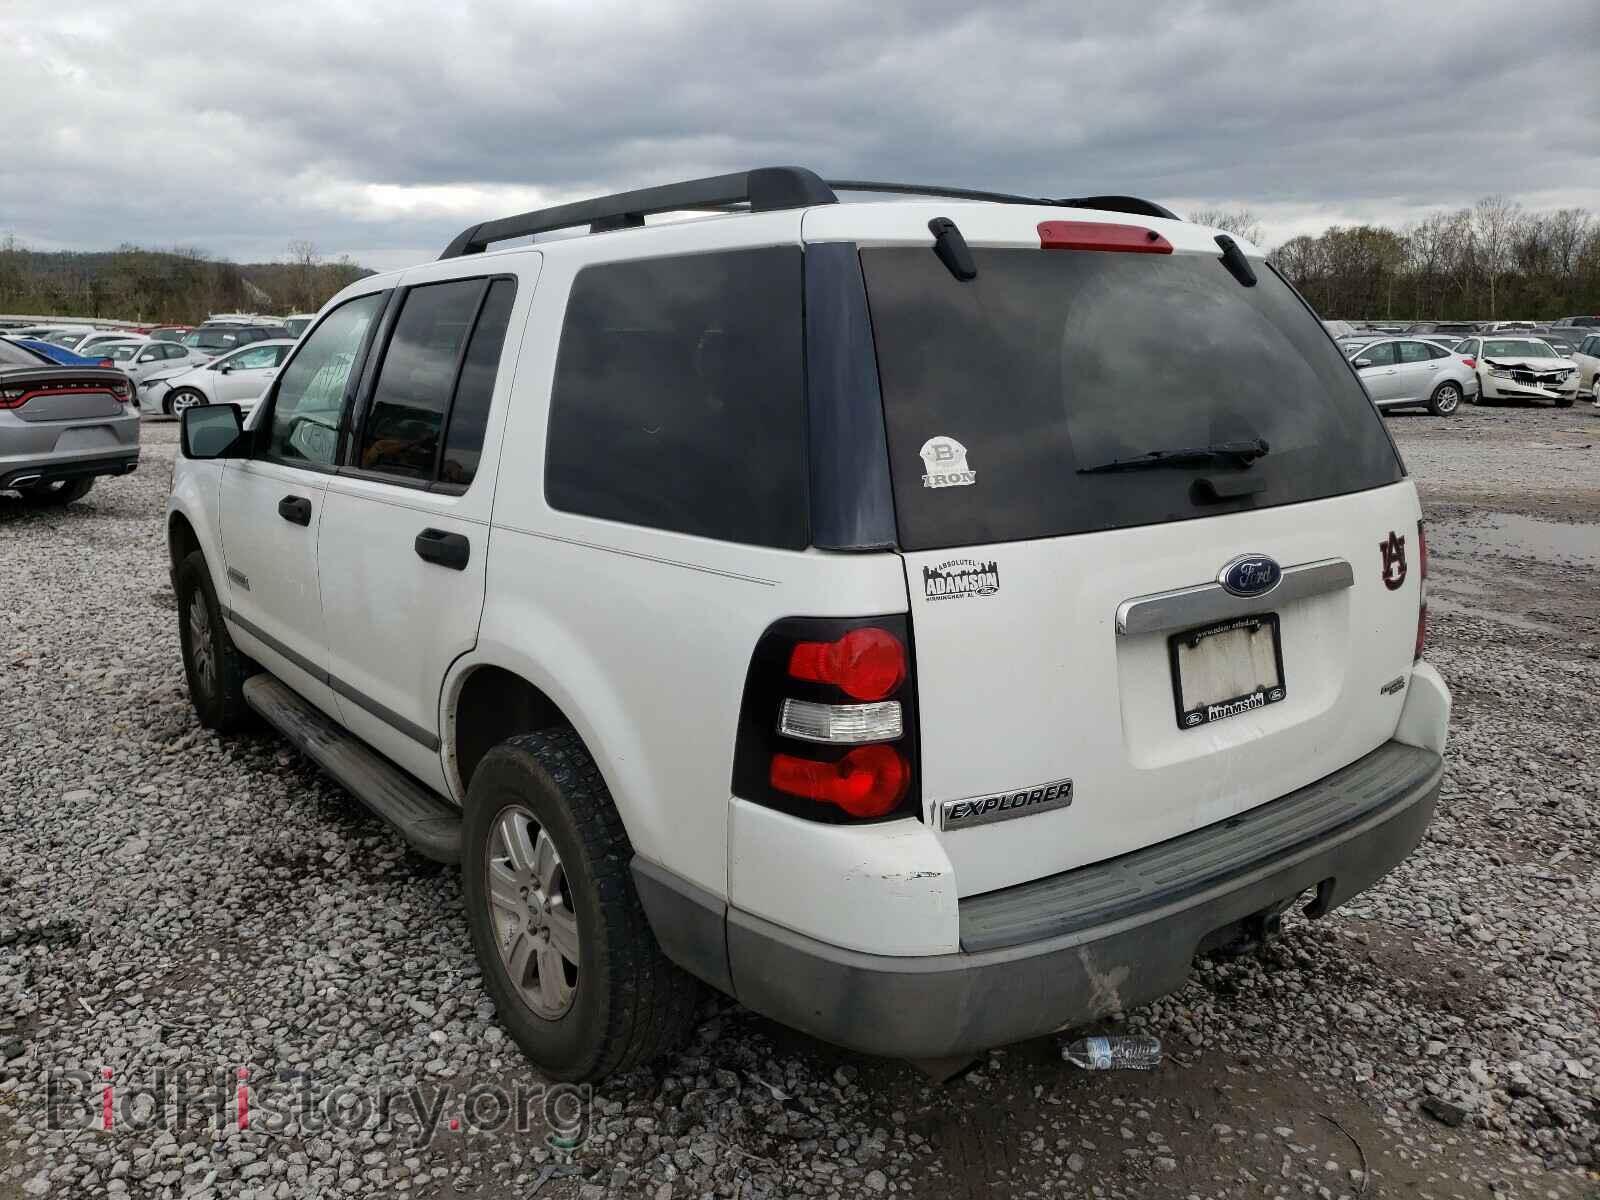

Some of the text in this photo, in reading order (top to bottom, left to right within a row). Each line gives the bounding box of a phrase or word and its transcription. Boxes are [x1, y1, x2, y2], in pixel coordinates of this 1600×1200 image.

[938, 559, 978, 571] ABSOLUTEL
[1239, 562, 1272, 587] Ford
[926, 572, 998, 596] ADAMSON
[1210, 696, 1264, 721] ADAMSON
[949, 782, 1072, 819] EXPLORER
